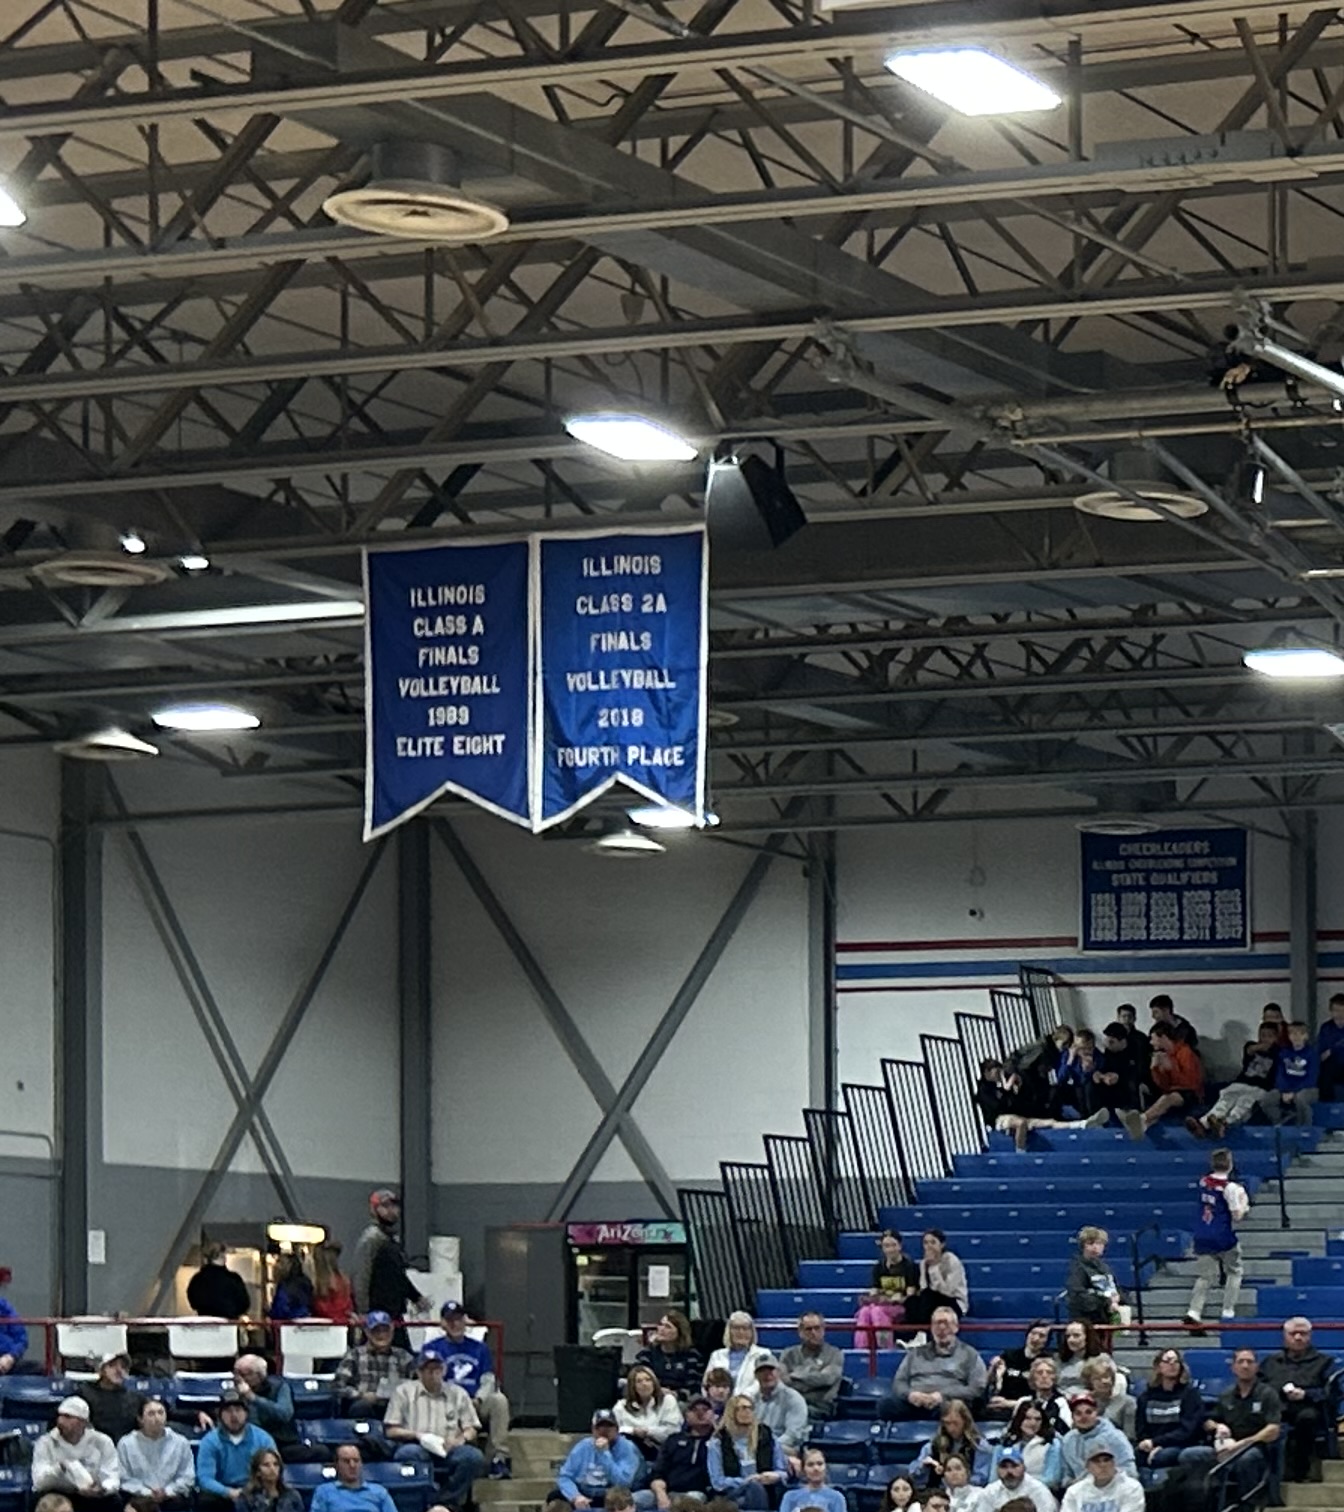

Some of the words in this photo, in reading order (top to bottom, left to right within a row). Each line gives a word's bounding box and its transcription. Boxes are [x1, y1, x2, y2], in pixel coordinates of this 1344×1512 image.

[583, 556, 661, 577] ILLINOIS
[410, 584, 485, 608] ILLINOIS
[575, 594, 633, 615] CLASS
[642, 594, 667, 613] 2A
[413, 616, 467, 637] CLASS
[472, 615, 484, 635] A
[590, 631, 652, 652] FINALS
[418, 646, 479, 668] FINALS
[399, 674, 500, 698] VOLLEYBALL
[566, 669, 676, 692] VOLLEYBALL
[598, 708, 644, 727] 2018
[396, 736, 444, 757] ELITE
[453, 734, 505, 754] EIGHT
[557, 746, 619, 767] FOURTH
[627, 745, 685, 766] PLACE
